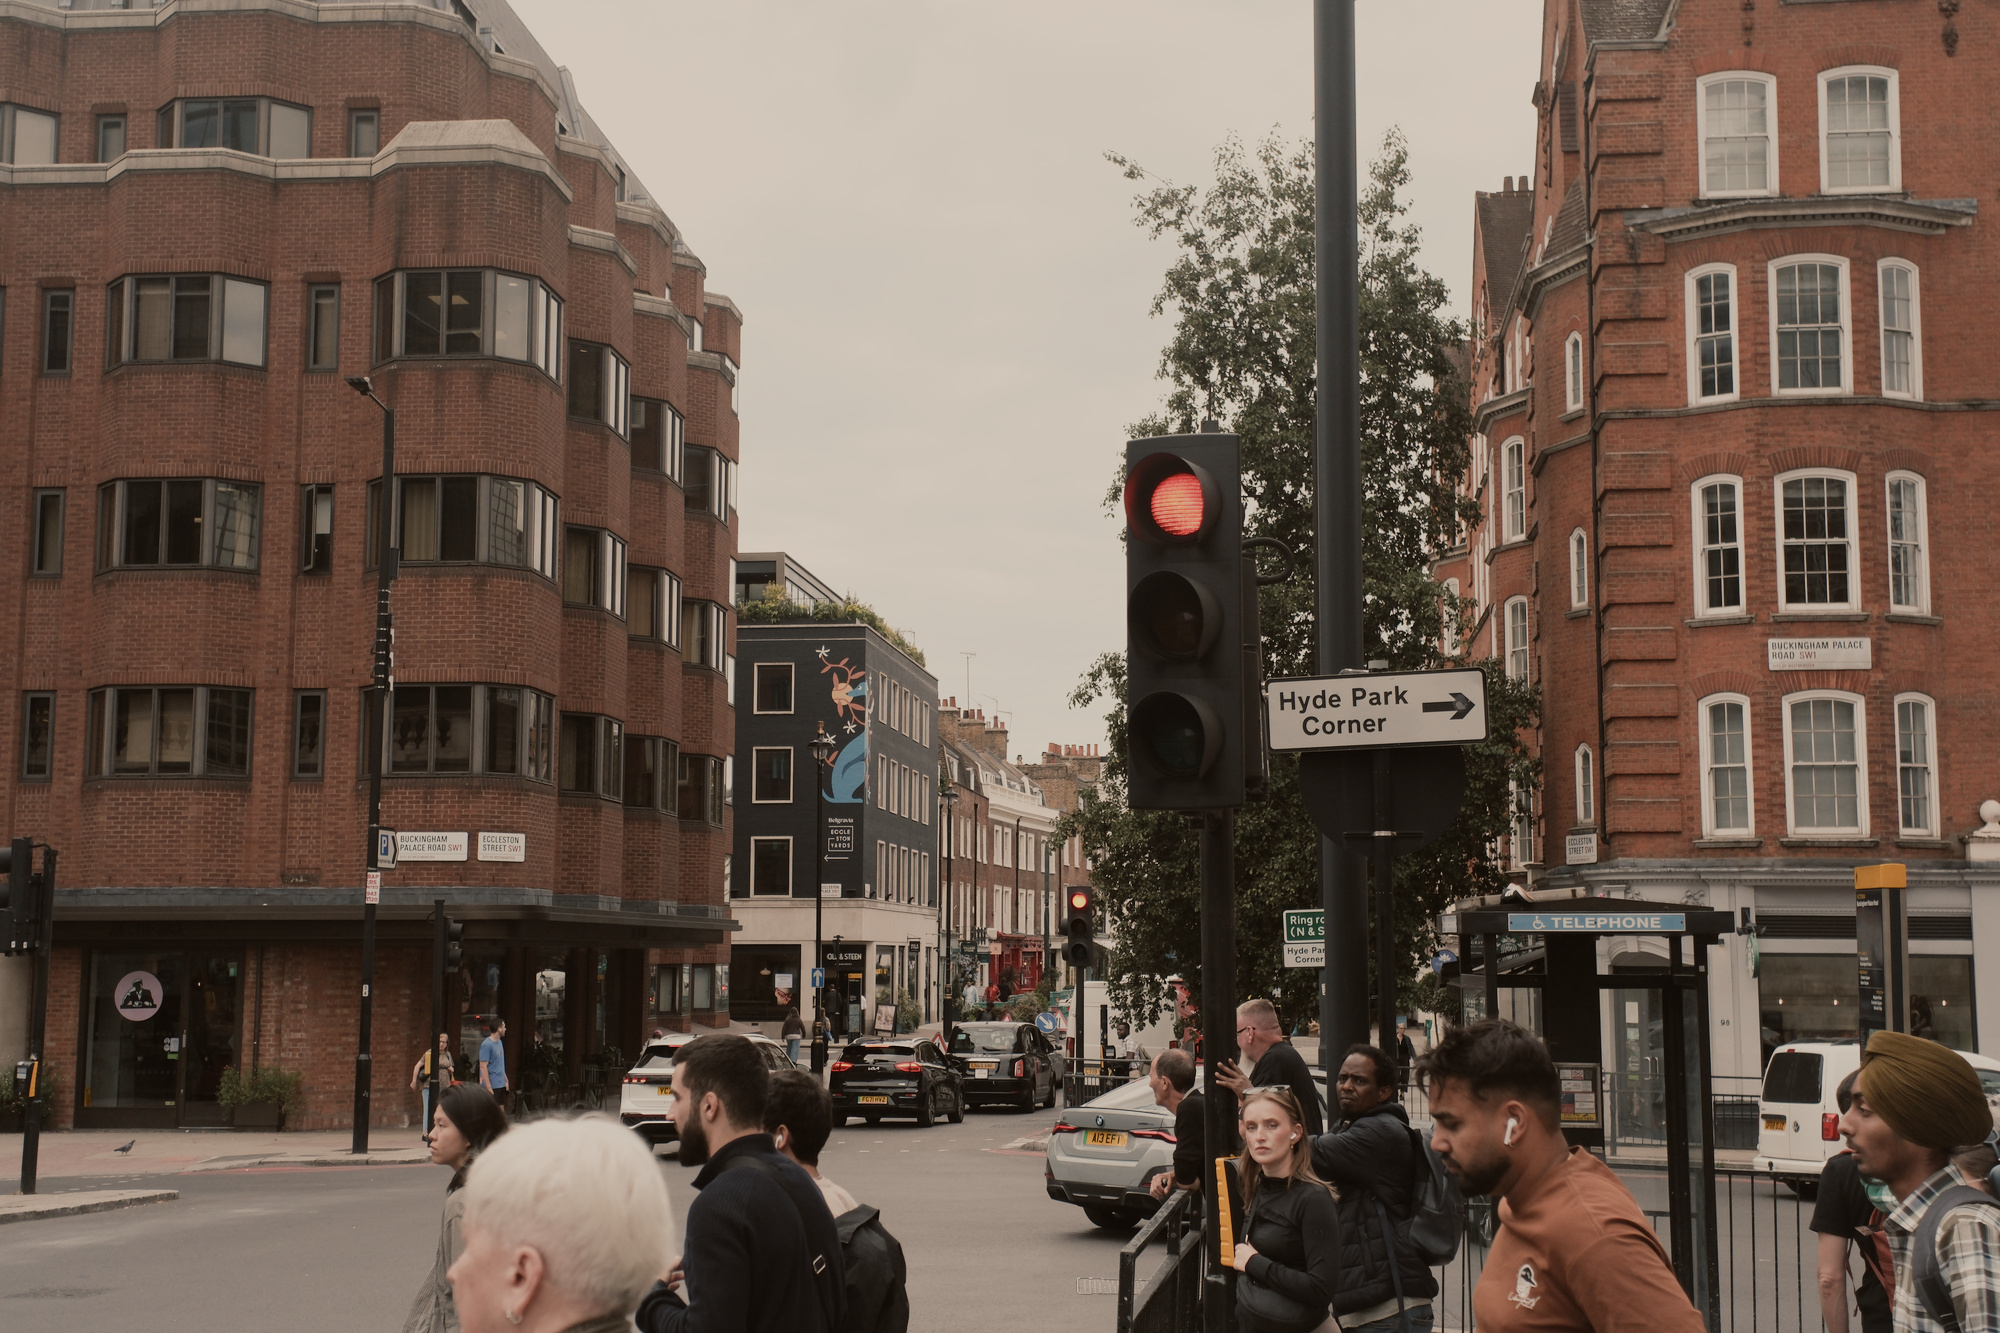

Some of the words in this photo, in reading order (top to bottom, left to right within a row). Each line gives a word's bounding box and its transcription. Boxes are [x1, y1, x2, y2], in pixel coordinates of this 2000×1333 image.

[1772, 641, 1829, 650] BUCKINGHAM
[1832, 641, 1864, 649] PALACE
[1772, 652, 1795, 660] ROAD
[1800, 651, 1816, 659] SW1
[1280, 690, 1341, 714] Hyde
[1352, 686, 1408, 706] Park
[1302, 716, 1386, 736] Corner
[382, 836, 387, 854] P
[1568, 837, 1592, 846] ECCLESTON
[1568, 847, 1584, 855] STREET
[1290, 916, 1313, 926] Ring
[1551, 917, 1661, 928] TELEPHONE
[1290, 927, 1305, 937] (N
[1308, 927, 1315, 936] &
[1318, 927, 1325, 936] S
[1092, 1133, 1105, 1143] A13
